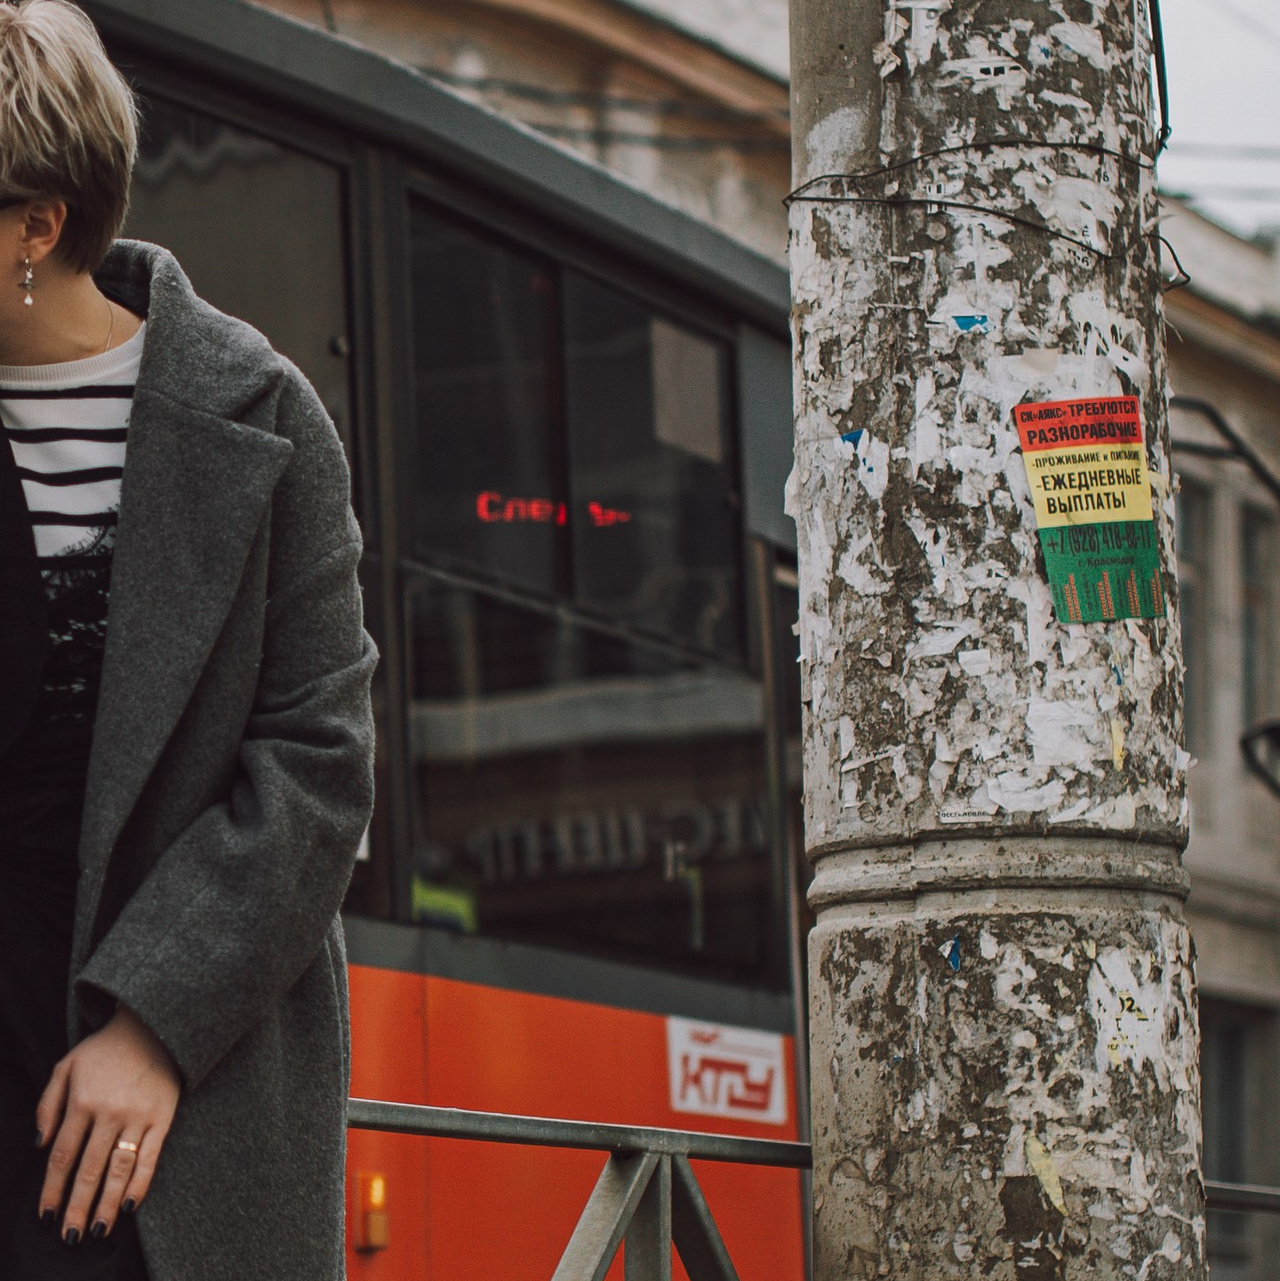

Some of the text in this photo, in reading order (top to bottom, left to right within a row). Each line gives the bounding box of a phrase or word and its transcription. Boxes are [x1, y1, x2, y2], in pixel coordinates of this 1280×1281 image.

[1068, 400, 1137, 418] ТРЕБУЮТСЯ
[1027, 421, 1138, 446] РАЗНОРАБОЧИЕ
[1046, 491, 1127, 515] ВЫПЛАТЫ
[1047, 528, 1065, 555] +7
[1068, 525, 1101, 556] (928)
